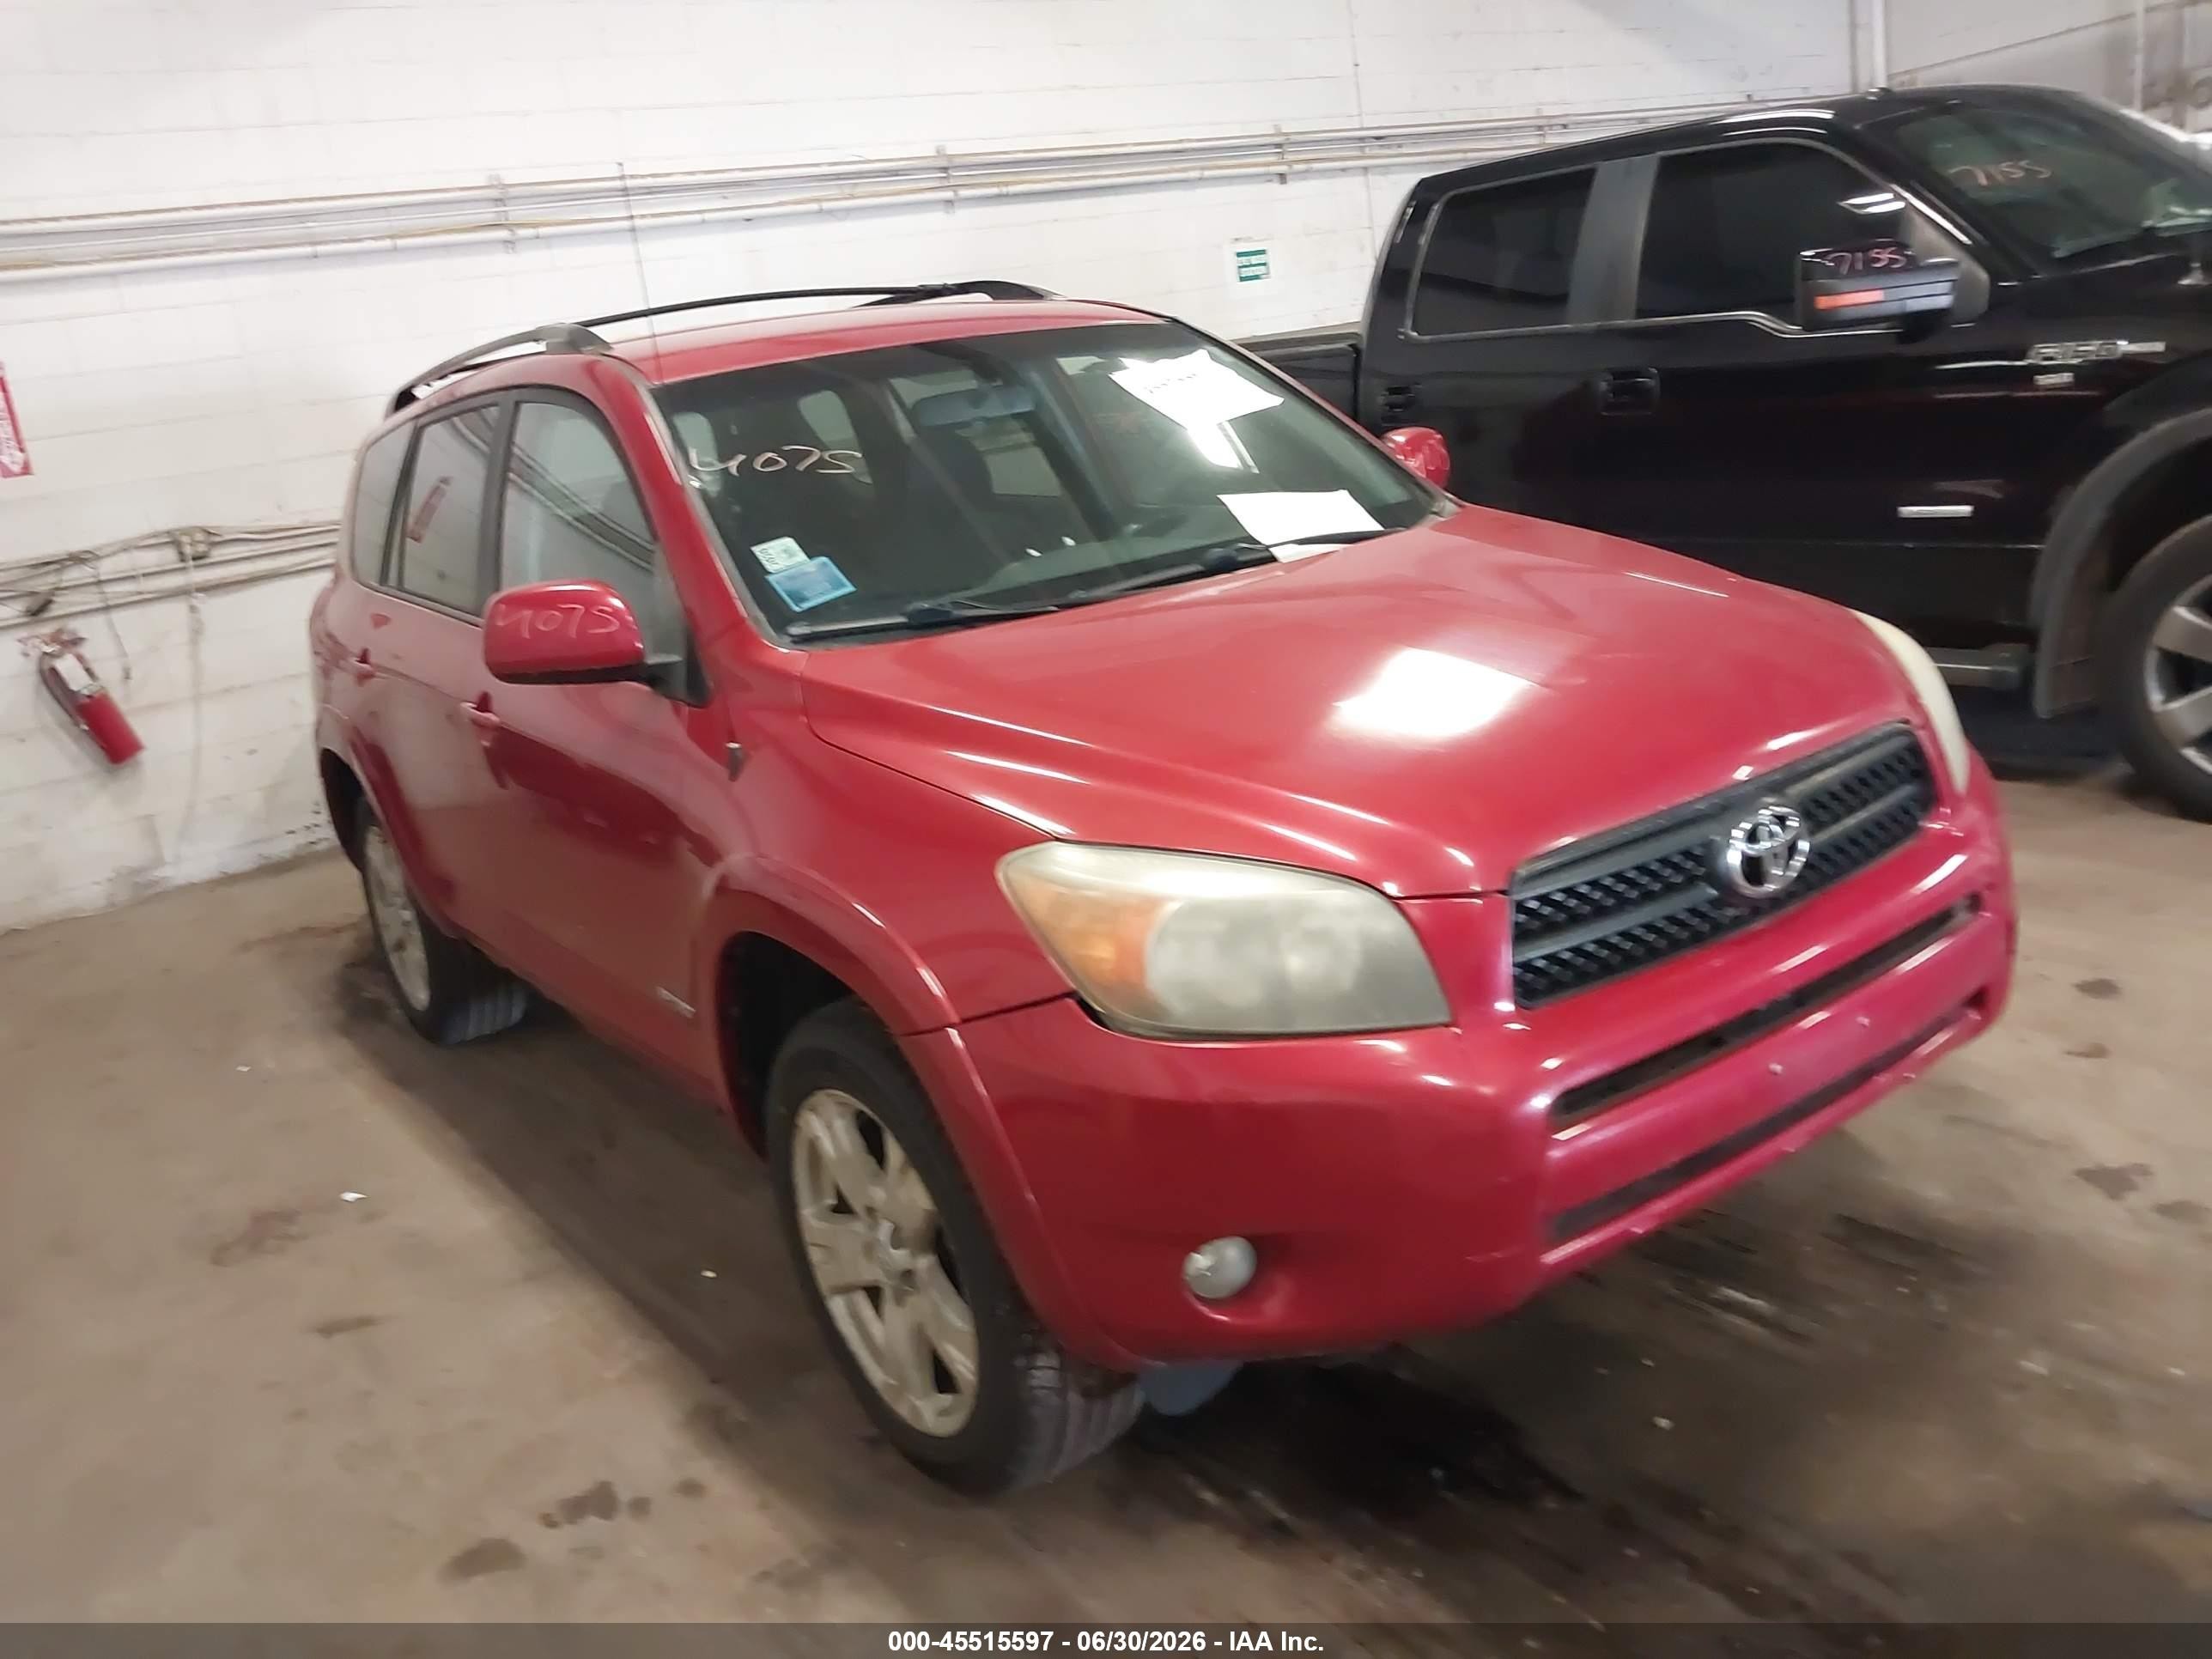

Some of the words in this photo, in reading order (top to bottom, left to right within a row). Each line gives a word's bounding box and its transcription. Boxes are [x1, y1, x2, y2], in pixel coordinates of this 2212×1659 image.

[1825, 246, 1907, 275] 7155
[688, 445, 863, 477] 4075
[494, 603, 621, 639] 4075
